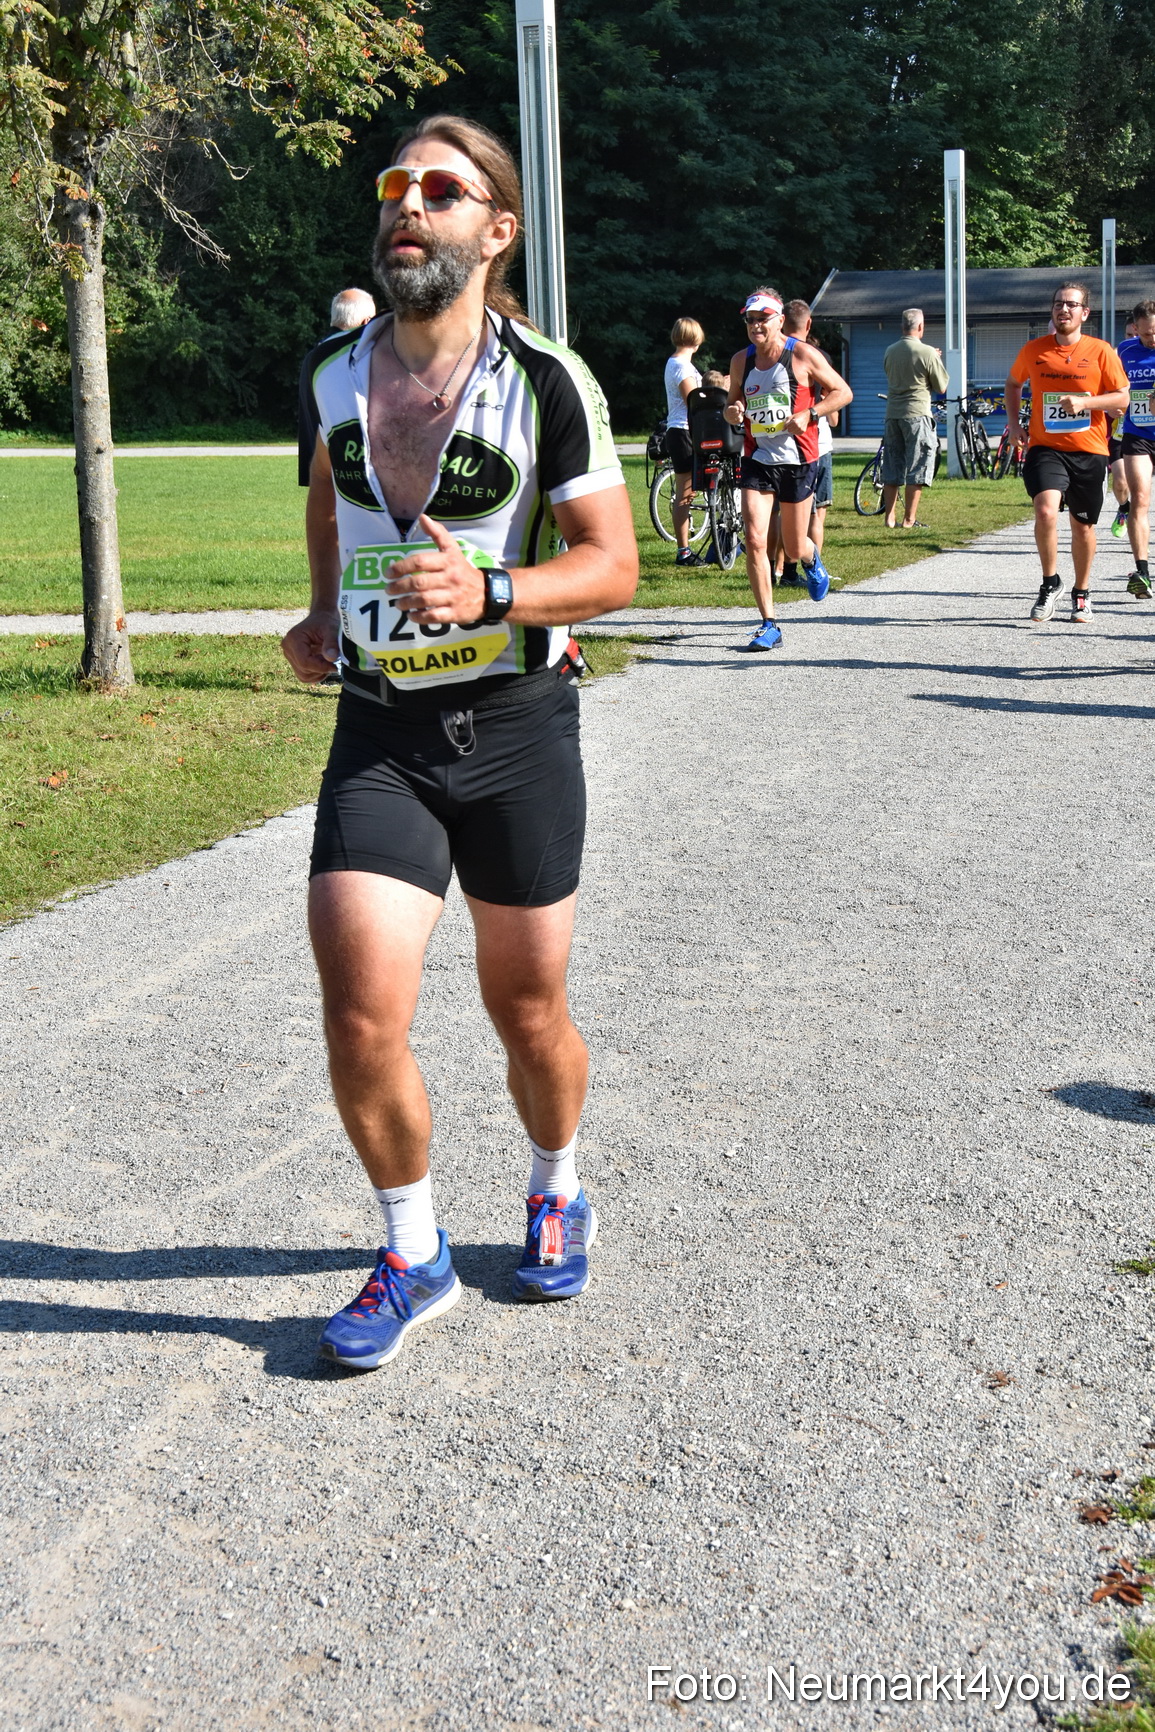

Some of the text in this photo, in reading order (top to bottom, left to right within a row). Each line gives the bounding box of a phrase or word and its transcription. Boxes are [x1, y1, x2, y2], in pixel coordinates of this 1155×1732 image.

[1134, 402, 1151, 414] 21
[751, 409, 786, 424] 1210
[376, 646, 478, 674] ROLAND
